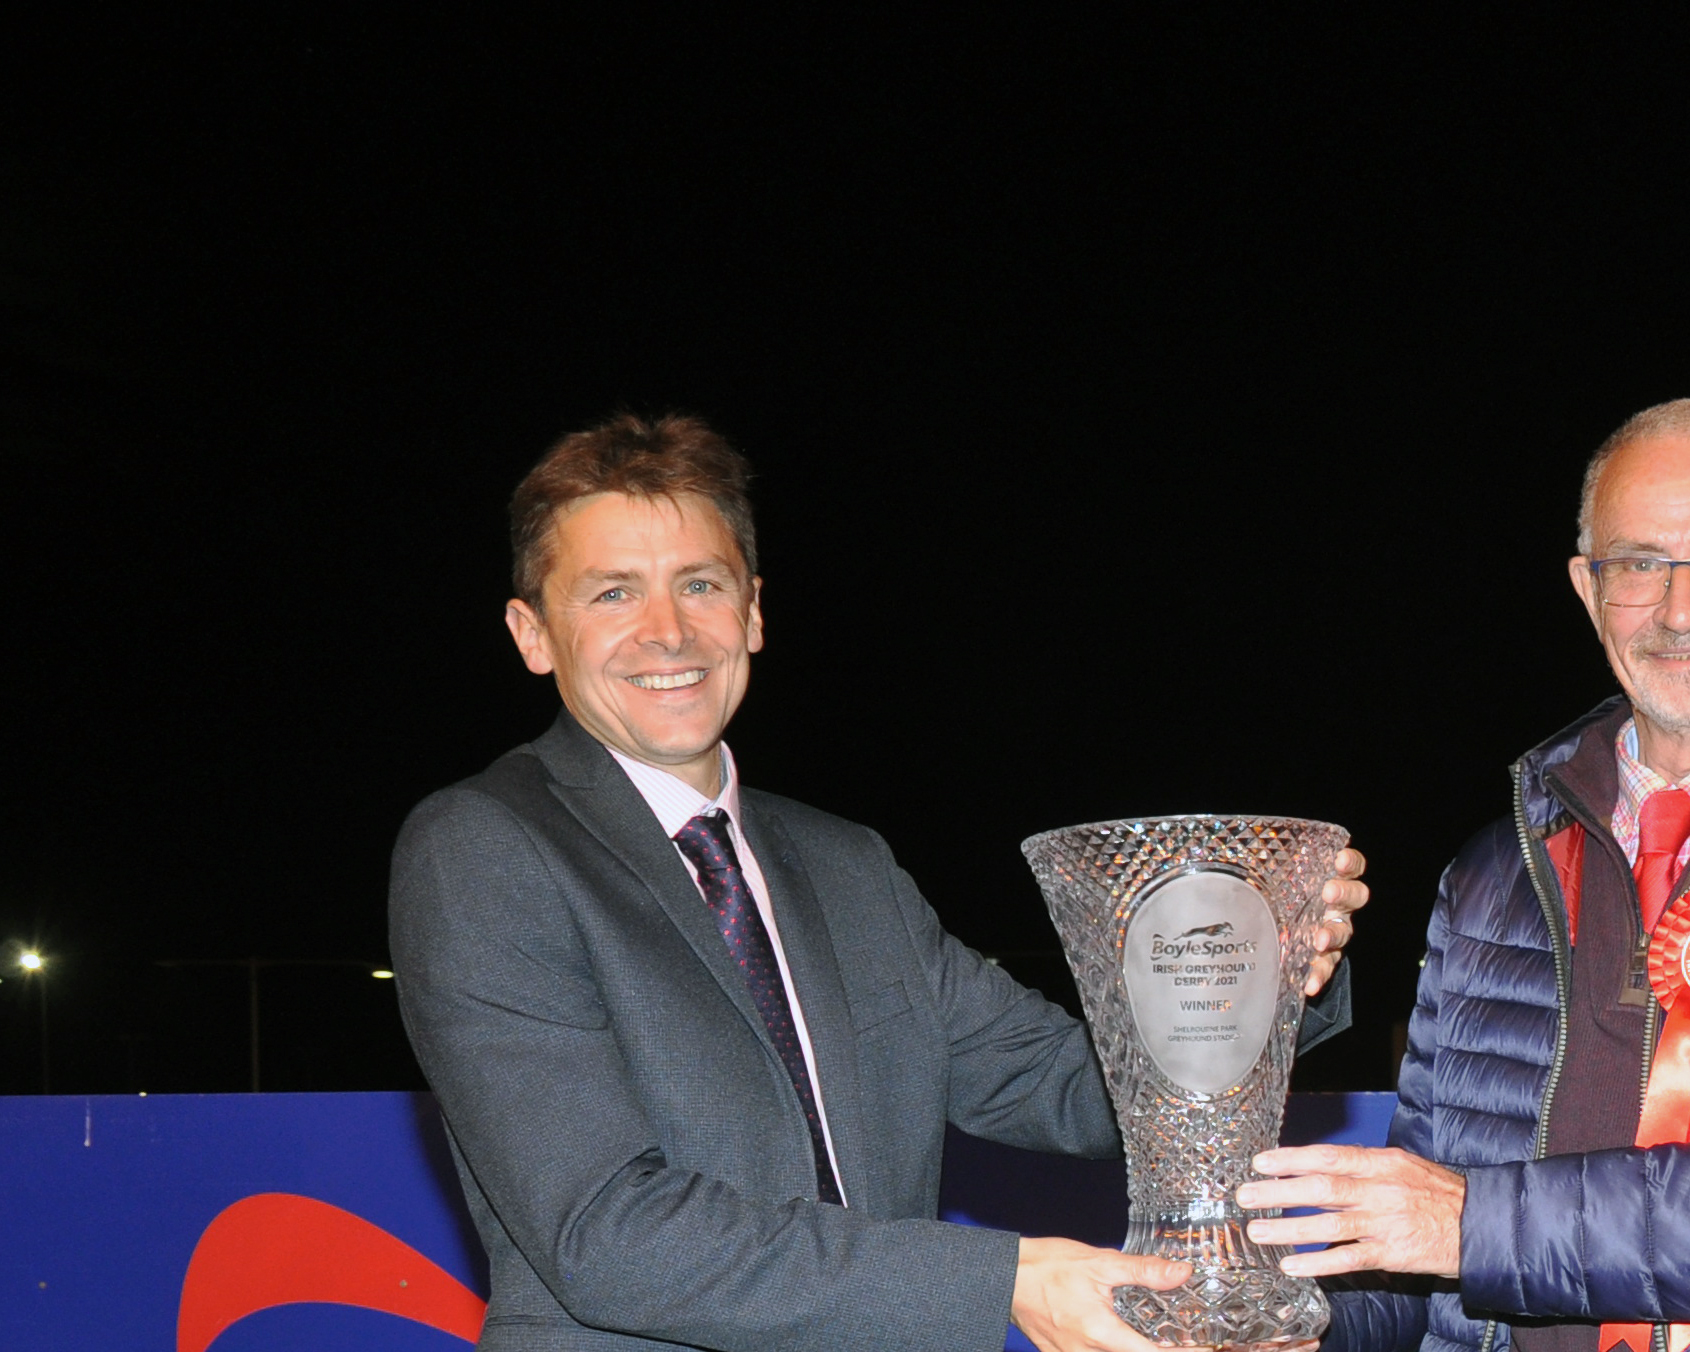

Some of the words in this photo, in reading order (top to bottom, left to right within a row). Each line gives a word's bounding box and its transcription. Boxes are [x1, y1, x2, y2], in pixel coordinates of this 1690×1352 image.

[1151, 940, 1258, 959] BoyleSports
[1214, 976, 1238, 986] 2021
[1180, 999, 1232, 1012] WINNER
